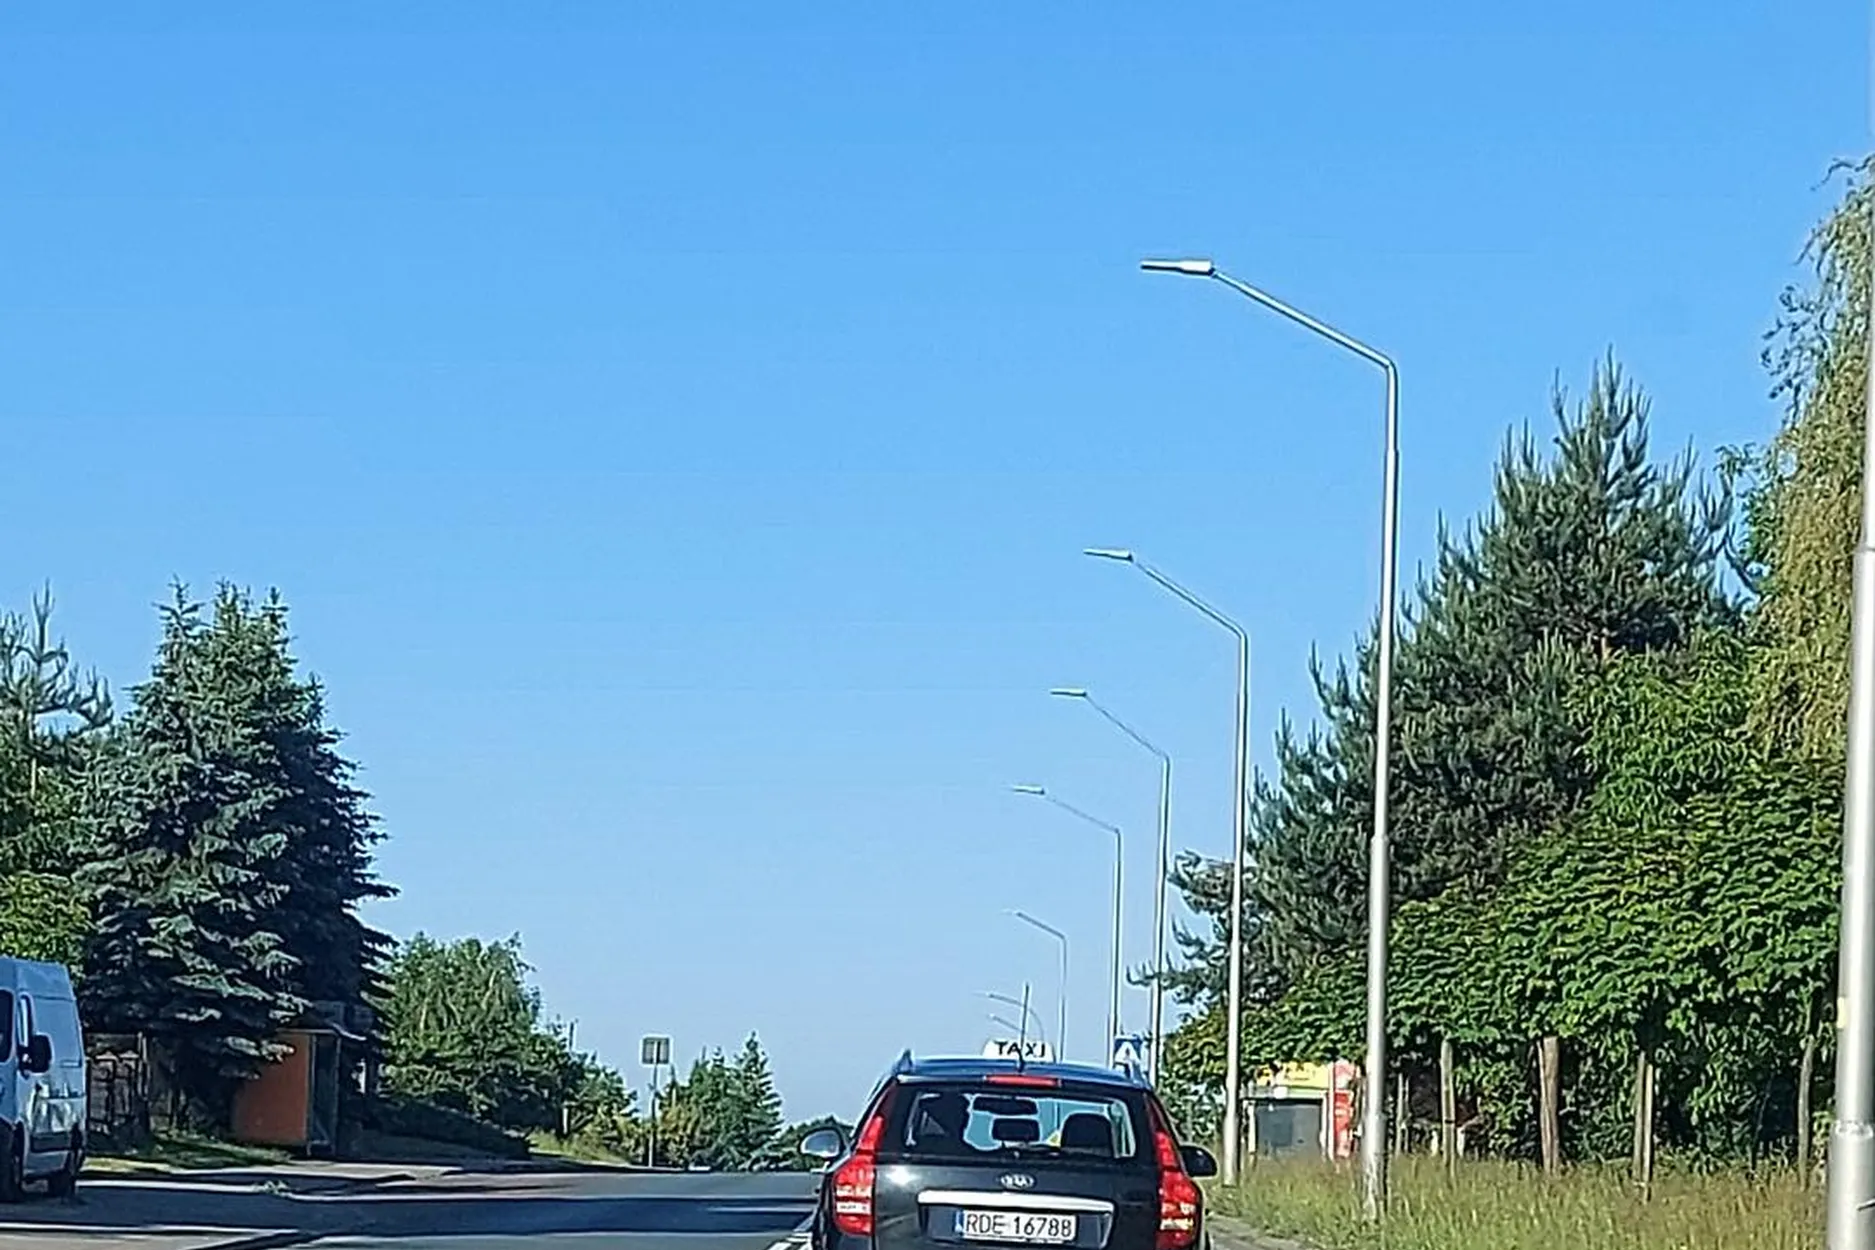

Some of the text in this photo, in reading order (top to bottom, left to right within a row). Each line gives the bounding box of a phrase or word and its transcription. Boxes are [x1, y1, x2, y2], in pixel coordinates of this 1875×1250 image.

[994, 1041, 1046, 1058] TAXI
[966, 1213, 1072, 1237] RDE 16788
